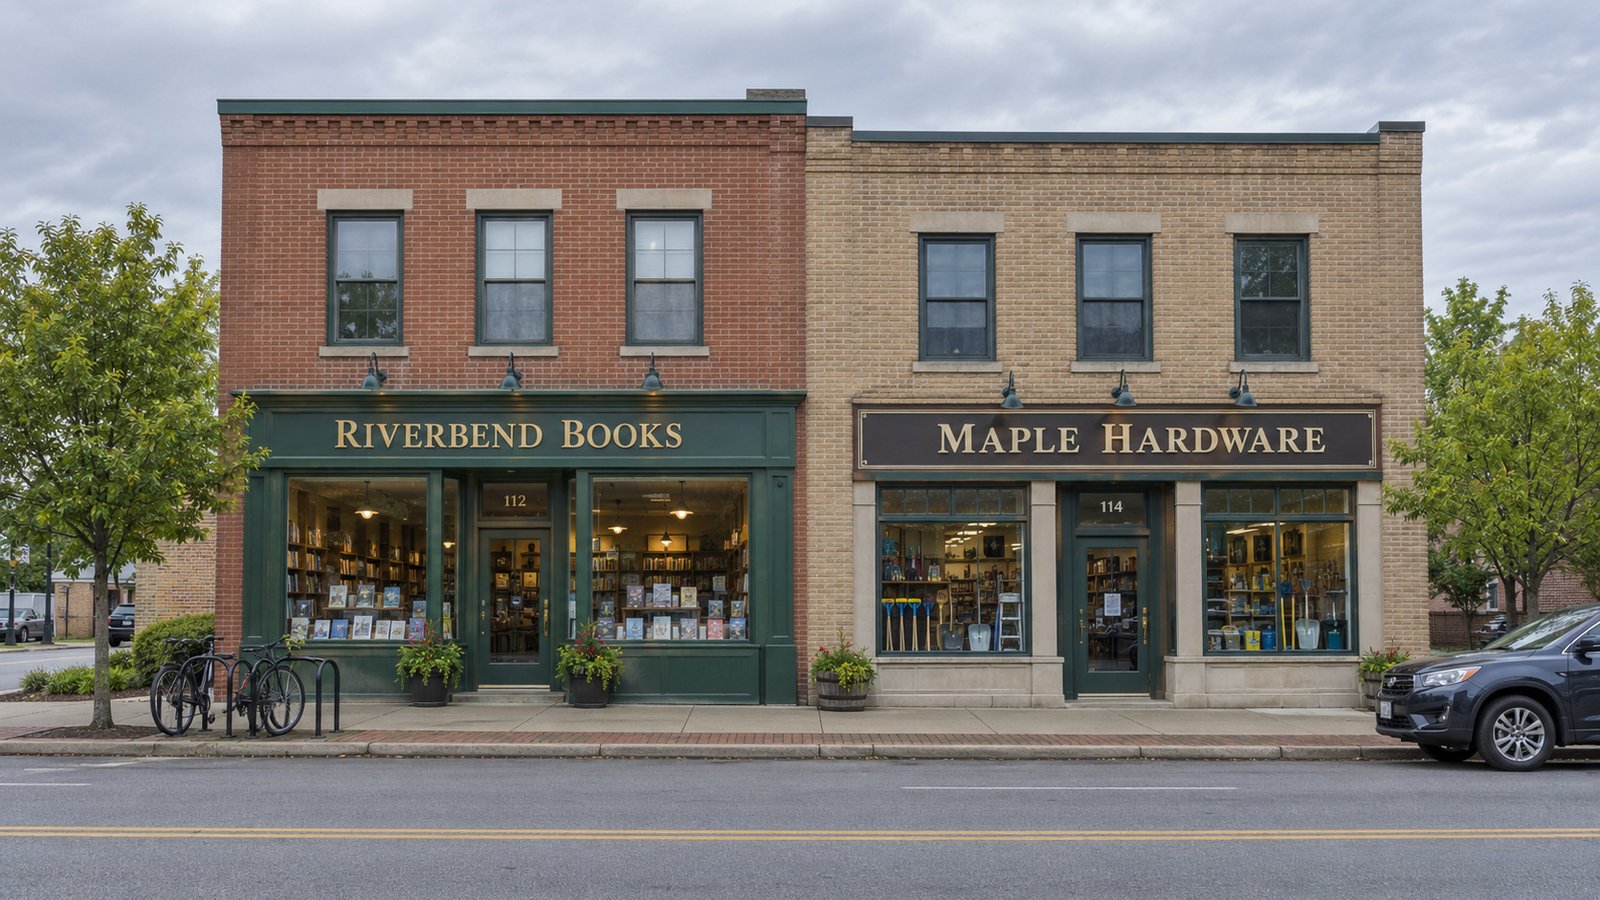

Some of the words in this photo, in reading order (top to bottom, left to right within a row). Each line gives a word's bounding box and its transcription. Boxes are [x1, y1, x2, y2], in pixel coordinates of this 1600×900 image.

[335, 419, 543, 449] RIVERBEND
[561, 419, 683, 449] BOOKS
[937, 423, 1080, 454] MAPLE
[1101, 423, 1326, 454] HARDWARE
[504, 495, 527, 507] 112
[1100, 501, 1123, 513] 114
